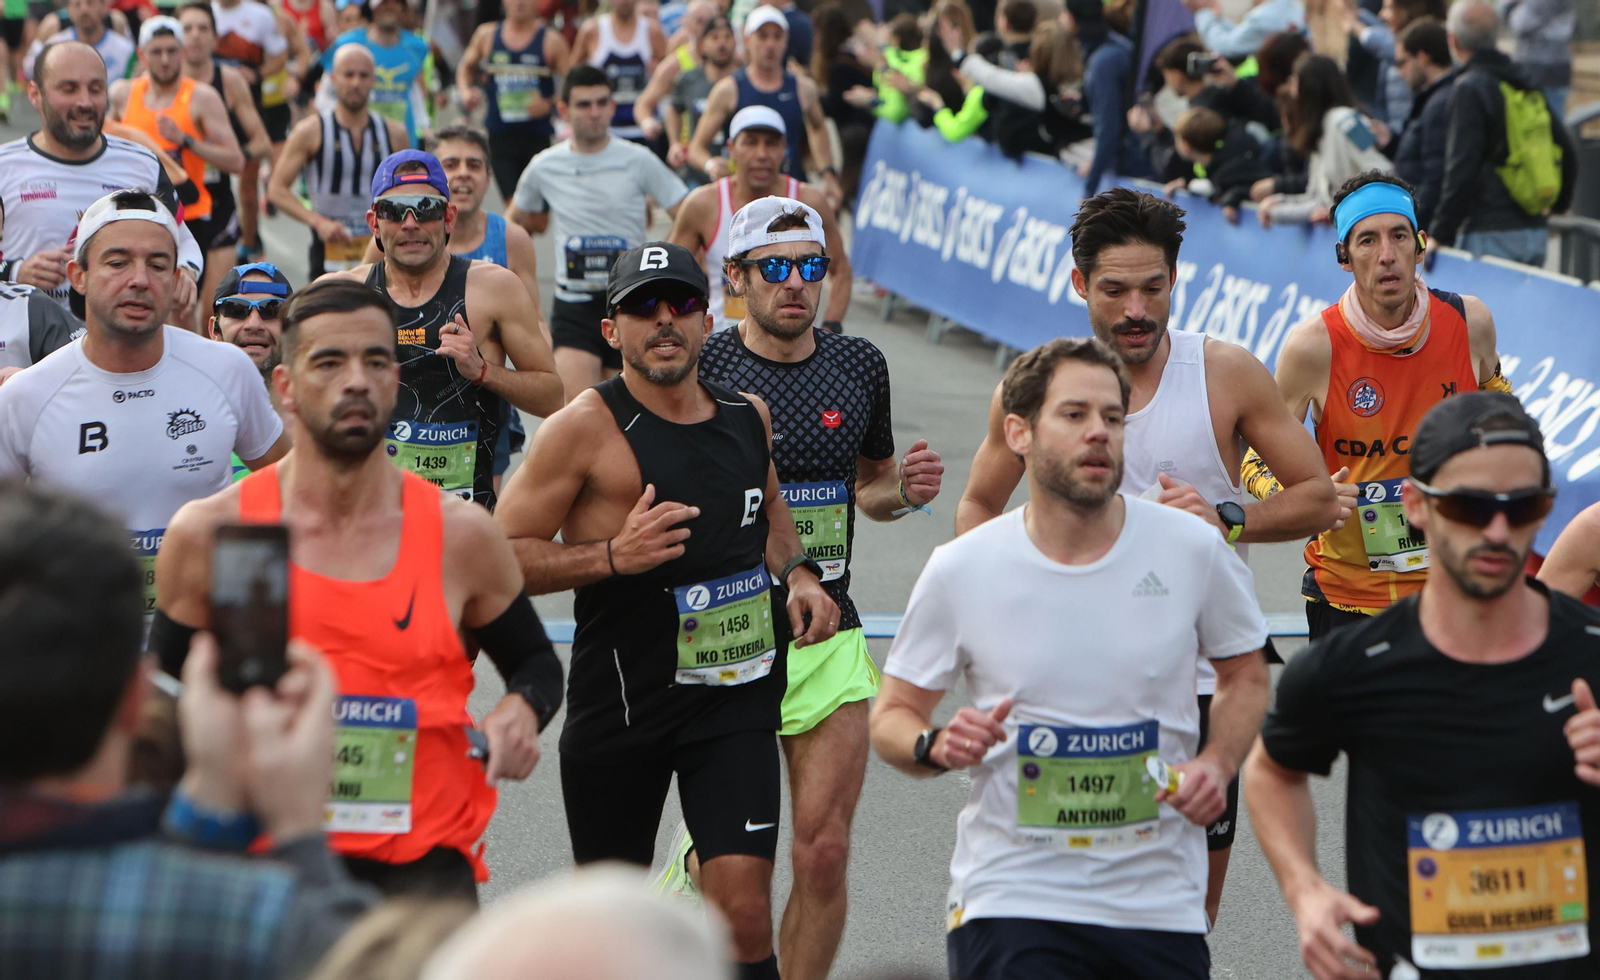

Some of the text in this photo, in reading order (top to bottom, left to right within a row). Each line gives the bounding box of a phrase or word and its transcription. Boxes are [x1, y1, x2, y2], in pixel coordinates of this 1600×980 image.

[127, 389, 155, 400] PACTO
[417, 427, 468, 441] ZURICH
[771, 433, 784, 441] illo
[1334, 436, 1411, 458] CDA C
[414, 455, 447, 469] 1439
[780, 487, 837, 502] ZURICH
[795, 520, 814, 536] 58
[130, 536, 165, 551] ZUR
[807, 544, 845, 559] MATEO
[716, 573, 764, 601] ZURICH
[718, 613, 750, 637] 1458
[696, 638, 766, 665] IKO TEIXEIRA
[332, 700, 402, 723] URICH
[1067, 731, 1145, 753] ZURICH
[336, 744, 364, 766] 45
[1066, 775, 1116, 794] 1497
[1056, 807, 1127, 824] ANTONIO
[1466, 812, 1564, 844] ZURICH
[1469, 867, 1526, 896] 3611
[1447, 904, 1554, 929] GUILHERME
